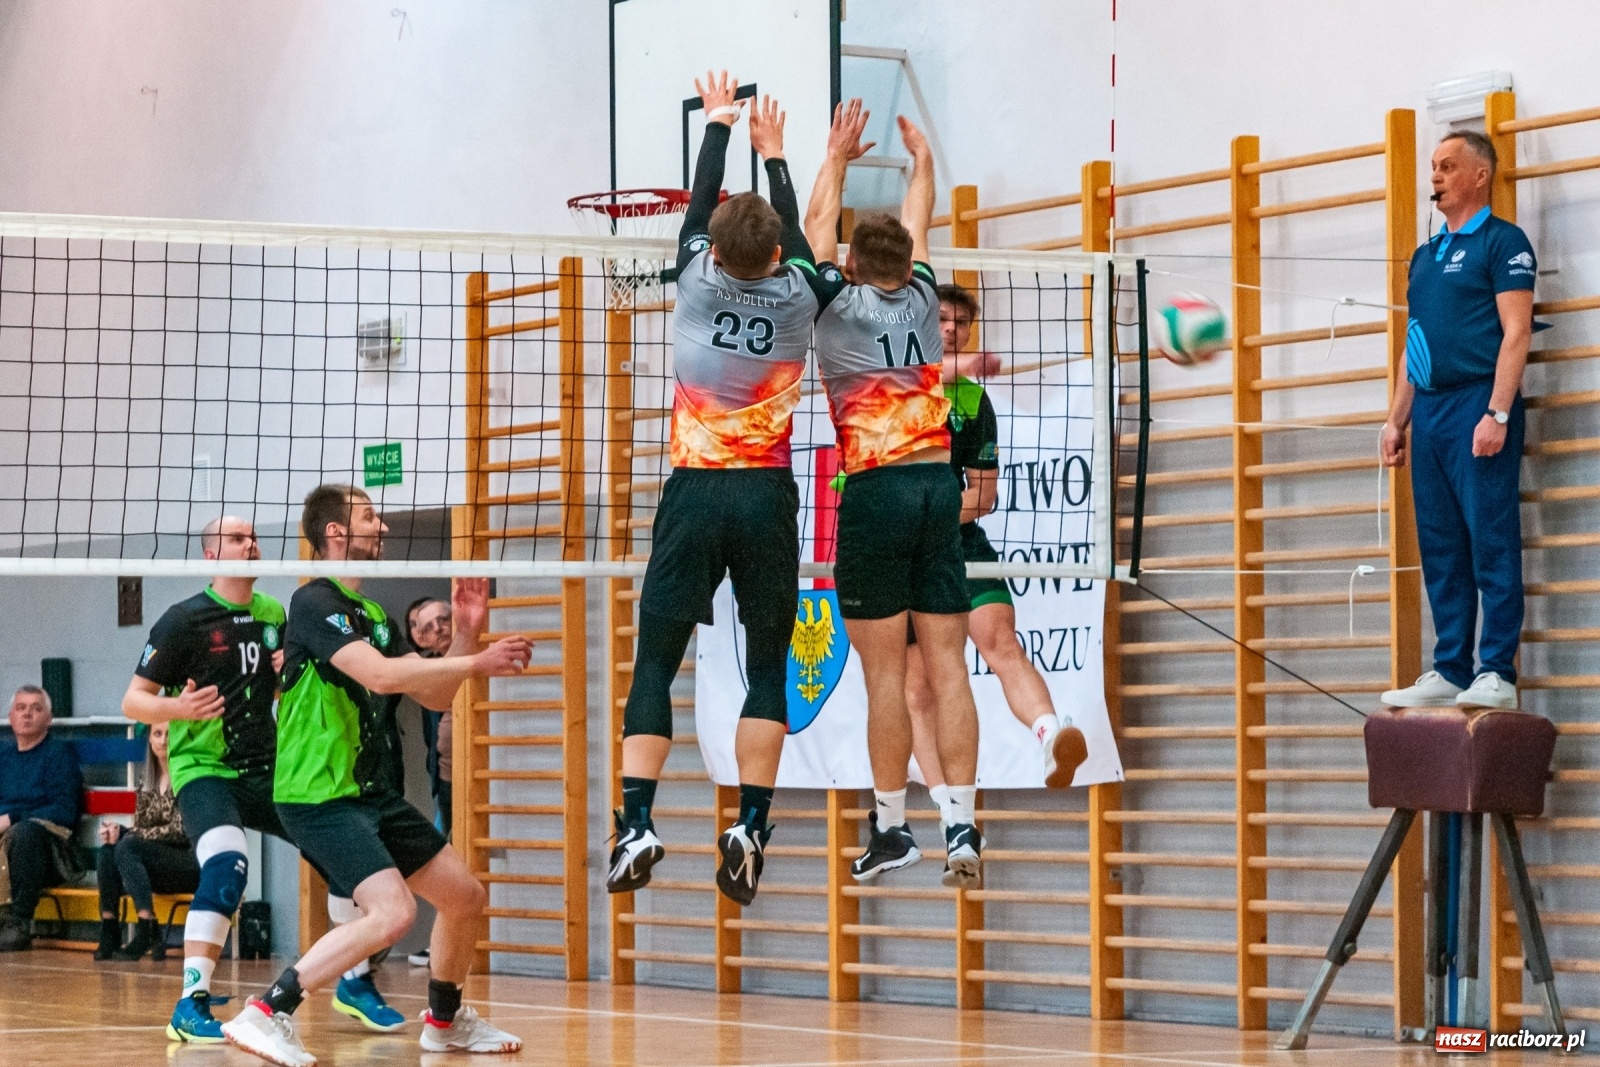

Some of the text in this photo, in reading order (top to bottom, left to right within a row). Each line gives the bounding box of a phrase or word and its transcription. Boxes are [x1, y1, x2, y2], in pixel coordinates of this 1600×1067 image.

[716, 287, 731, 301] KS
[711, 310, 776, 356] 23
[868, 309, 882, 323] KS
[875, 328, 928, 367] 14
[989, 454, 1092, 512] TWO
[997, 543, 1093, 597] OWE
[238, 641, 260, 675] 19
